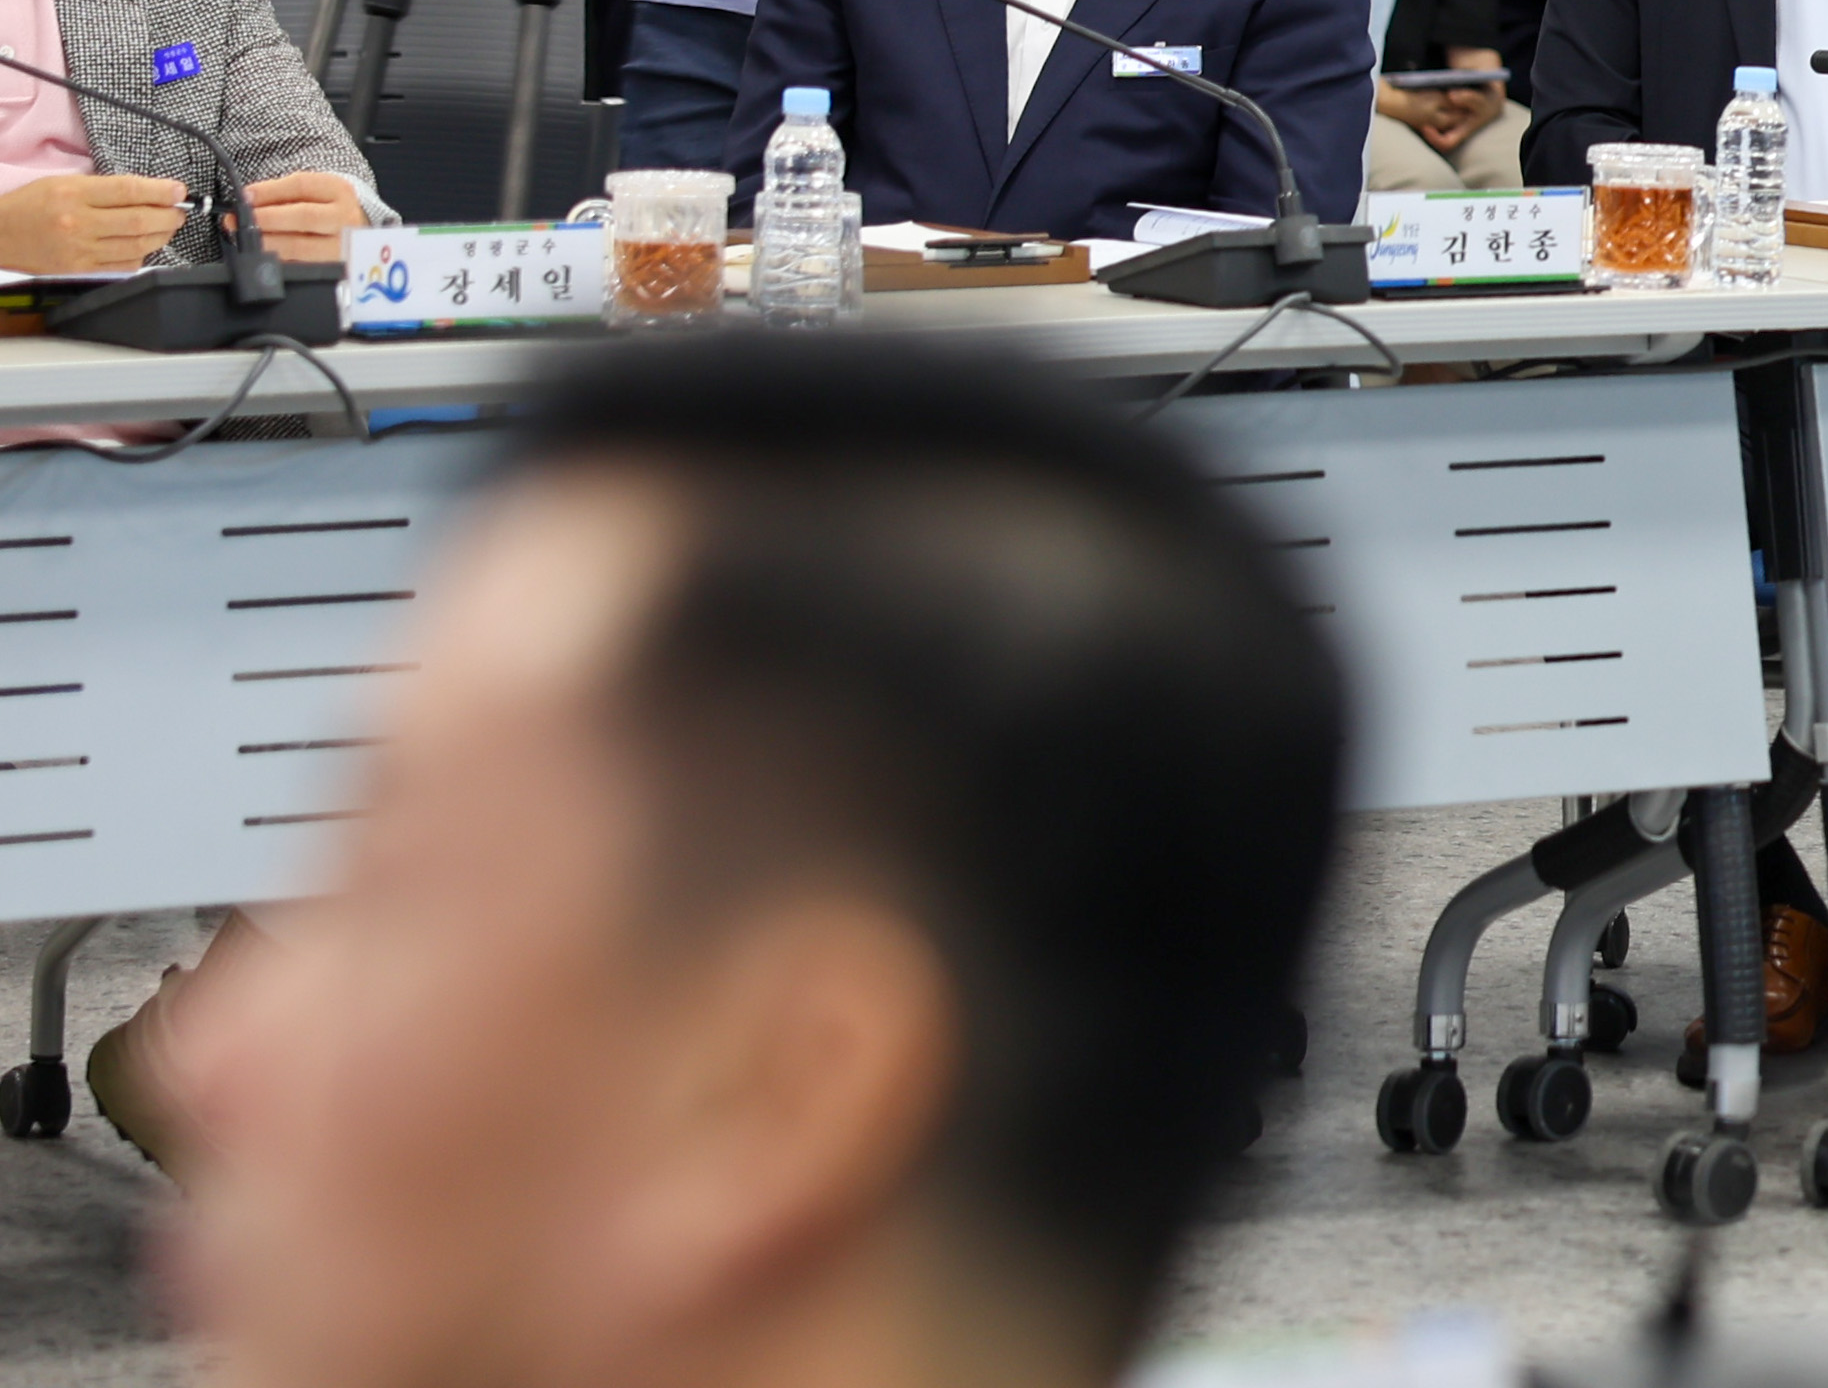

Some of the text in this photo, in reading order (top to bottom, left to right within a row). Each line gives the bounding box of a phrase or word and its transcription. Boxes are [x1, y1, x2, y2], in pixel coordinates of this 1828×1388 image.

[1462, 204, 1542, 222] 장성군수
[462, 237, 556, 258] 영광군수
[1442, 228, 1558, 265] 김한종
[440, 264, 575, 306] 장세일
